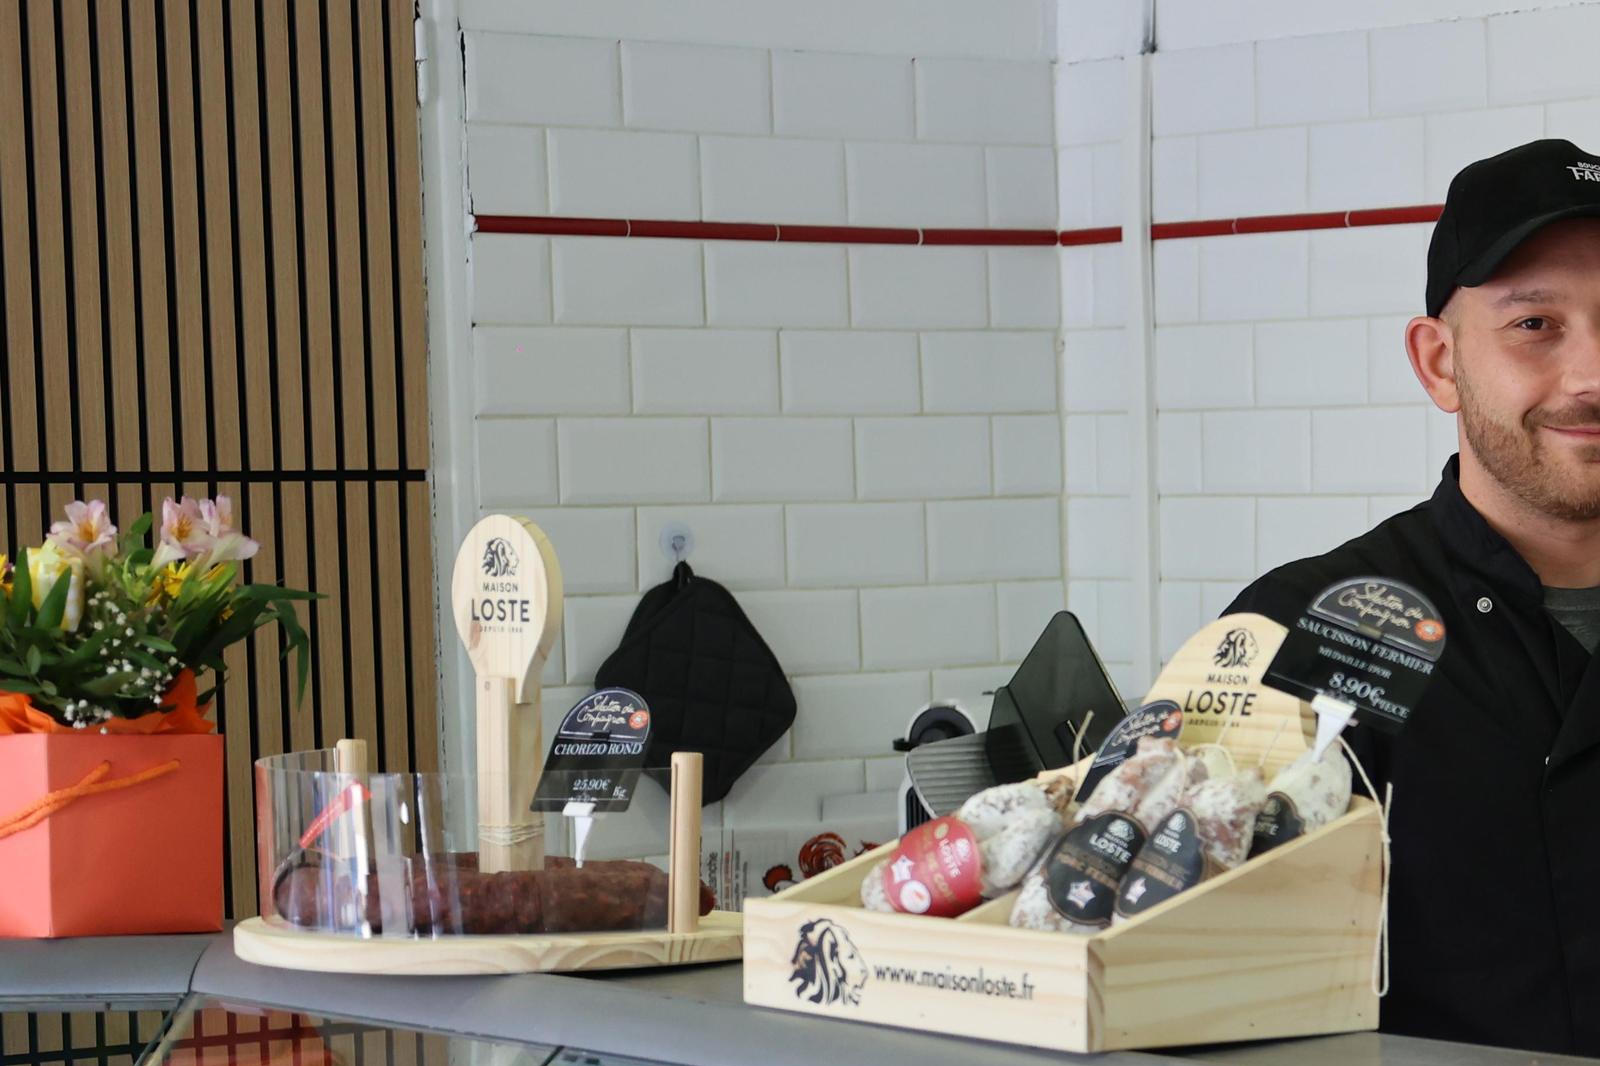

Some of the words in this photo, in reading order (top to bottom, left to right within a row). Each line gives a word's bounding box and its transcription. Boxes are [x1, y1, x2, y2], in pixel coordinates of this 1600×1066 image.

[482, 582, 519, 592] MAISON
[471, 598, 530, 622] LOSTE
[1296, 616, 1372, 652] SAUCISSON
[1371, 642, 1436, 675] FERMIER
[1206, 673, 1249, 686] MAISON
[1184, 690, 1258, 716] LOSTE
[554, 743, 608, 756] CHORIZO
[607, 743, 643, 756] ROND
[612, 786, 626, 799] Kg
[1088, 833, 1132, 863] LOSTE
[1153, 834, 1182, 853] LOSTE
[874, 965, 1035, 1000] www.maisonloste.fr
